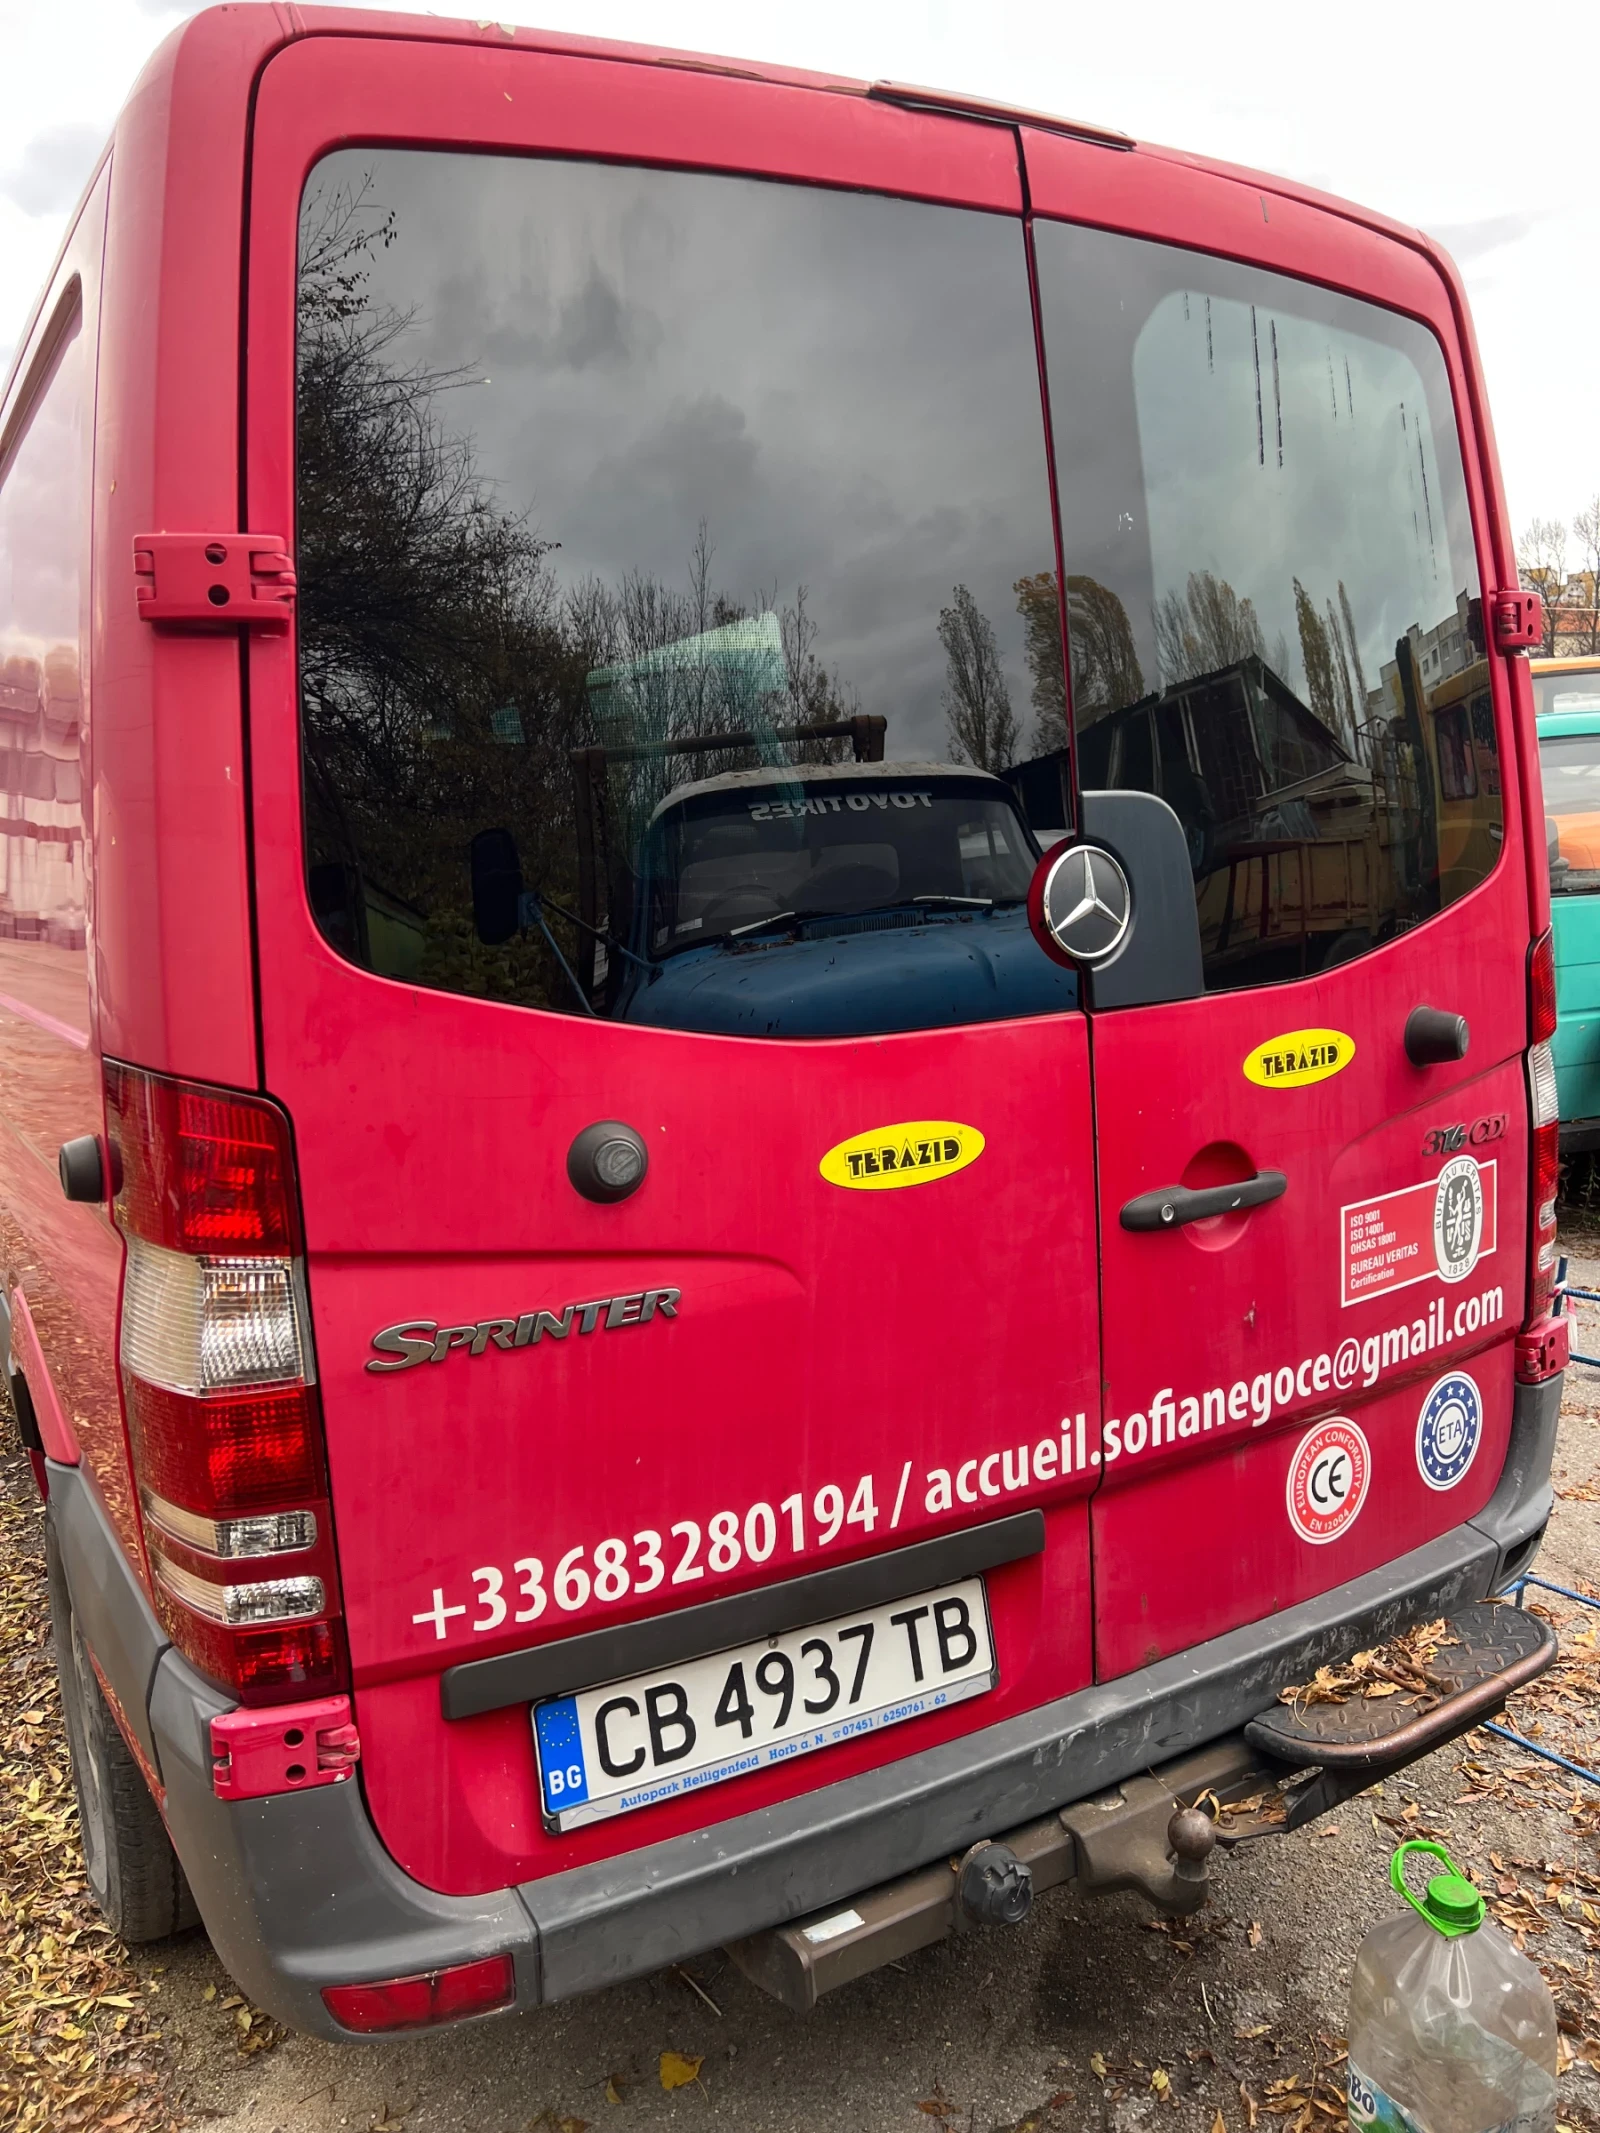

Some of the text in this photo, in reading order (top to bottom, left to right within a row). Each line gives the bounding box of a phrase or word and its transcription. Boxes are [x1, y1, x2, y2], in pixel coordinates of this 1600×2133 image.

[1422, 1123, 1467, 1156] 316
[1435, 1163, 1482, 1230] BUREAU VERITAS
[1350, 1210, 1380, 1228] ISO 9001
[1350, 1222, 1384, 1241] ISO 14001
[1350, 1231, 1396, 1255] OHSAS 18001
[1350, 1242, 1418, 1276] BUREAU VERITAS
[1350, 1268, 1395, 1290] Certification
[1449, 1260, 1469, 1274] 1828
[365, 1287, 681, 1371] SPRINTER
[1439, 1419, 1463, 1445] ETA
[412, 1474, 879, 1640] +33683280194
[925, 1285, 1504, 1514] accueil.sofianegoce@gmail.com
[1296, 1431, 1363, 1509] EUROPEAN CONFORMITY
[1311, 1455, 1345, 1503] CE
[1309, 1508, 1350, 1531] EN 12004
[594, 1597, 977, 1777] CB 4937 TB
[548, 1764, 583, 1796] BG
[620, 1783, 679, 1809] Autopark
[683, 1755, 759, 1789] Heiligenfeld
[769, 1743, 797, 1760] Horb
